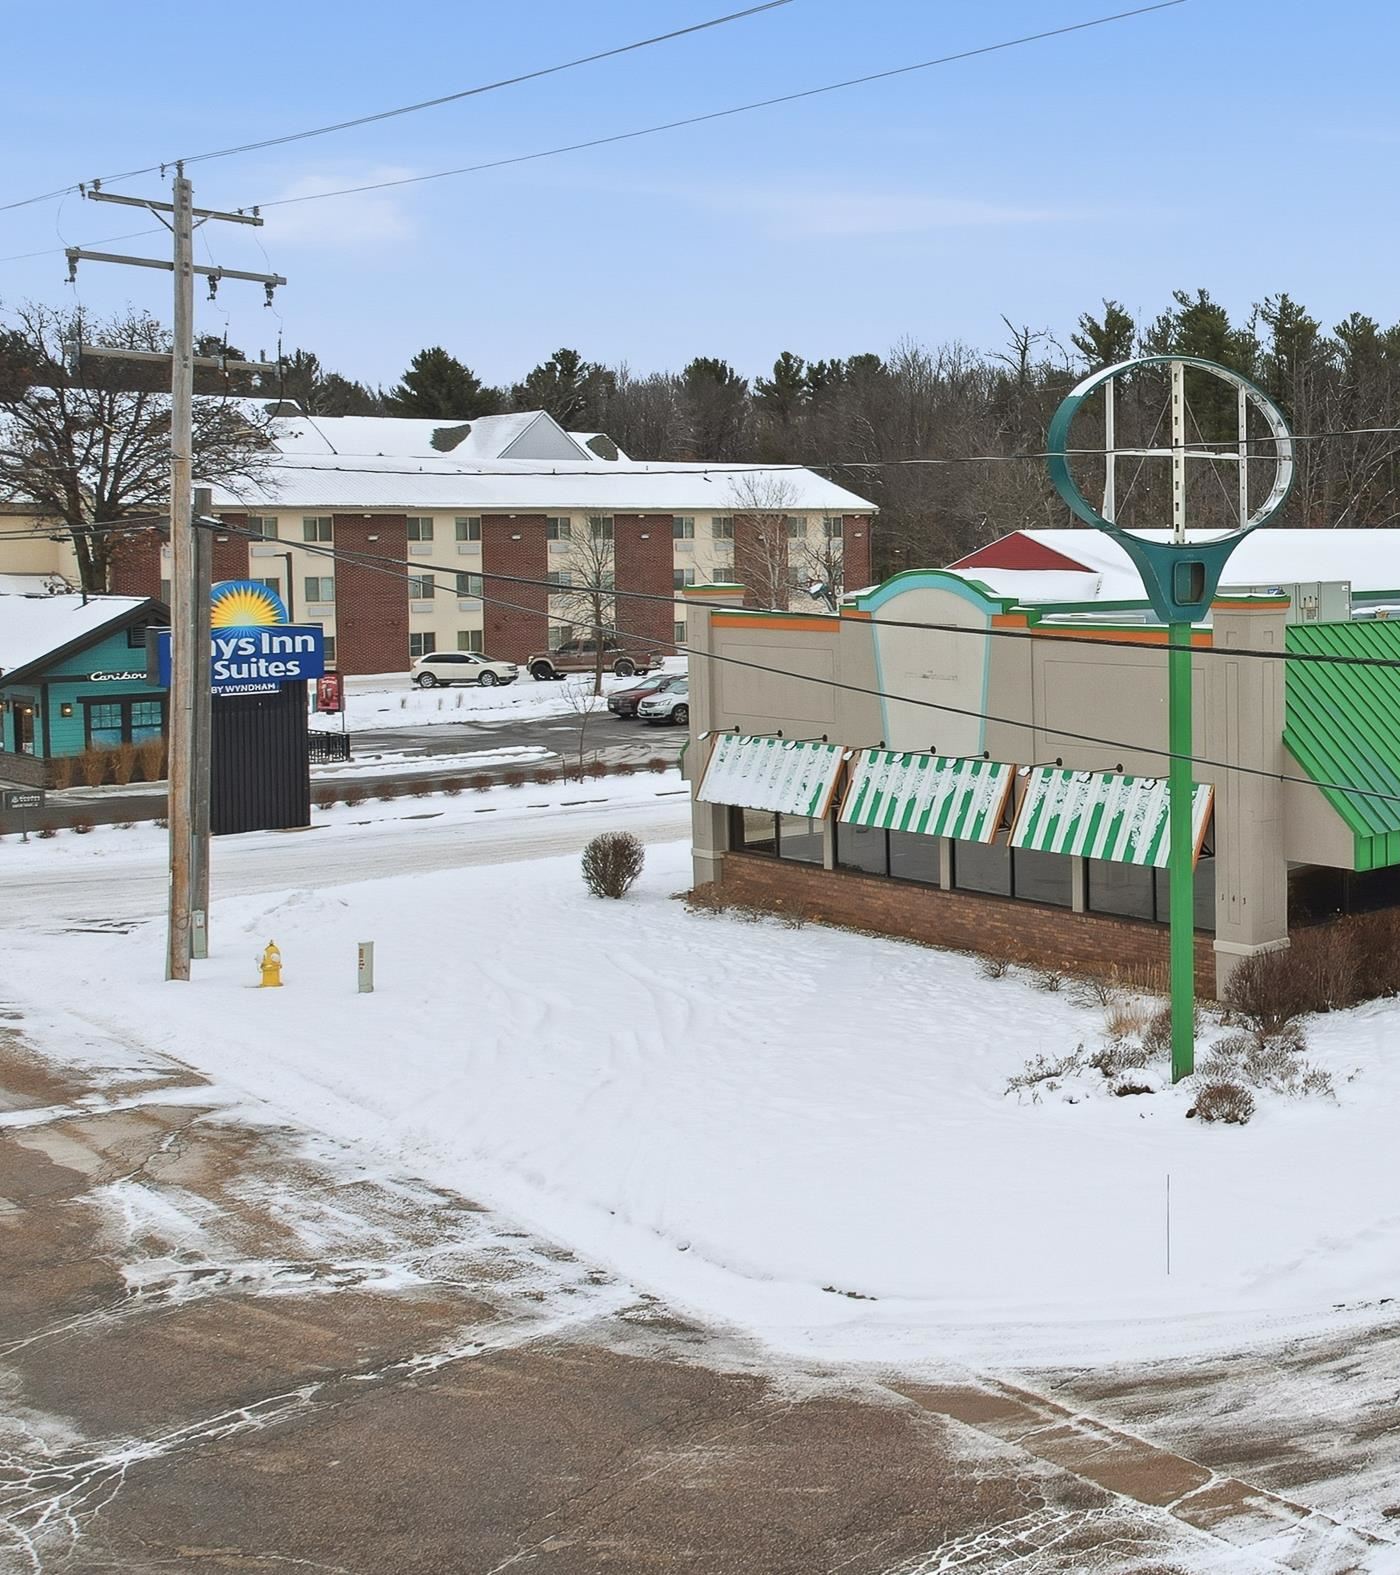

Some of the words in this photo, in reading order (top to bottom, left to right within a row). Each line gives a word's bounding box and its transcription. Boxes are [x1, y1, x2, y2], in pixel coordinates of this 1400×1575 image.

[261, 632, 315, 654] Inn
[90, 671, 147, 681] Caribou
[214, 658, 301, 680] Suites
[211, 686, 224, 694] BY
[225, 683, 276, 693] WYNDHAM
